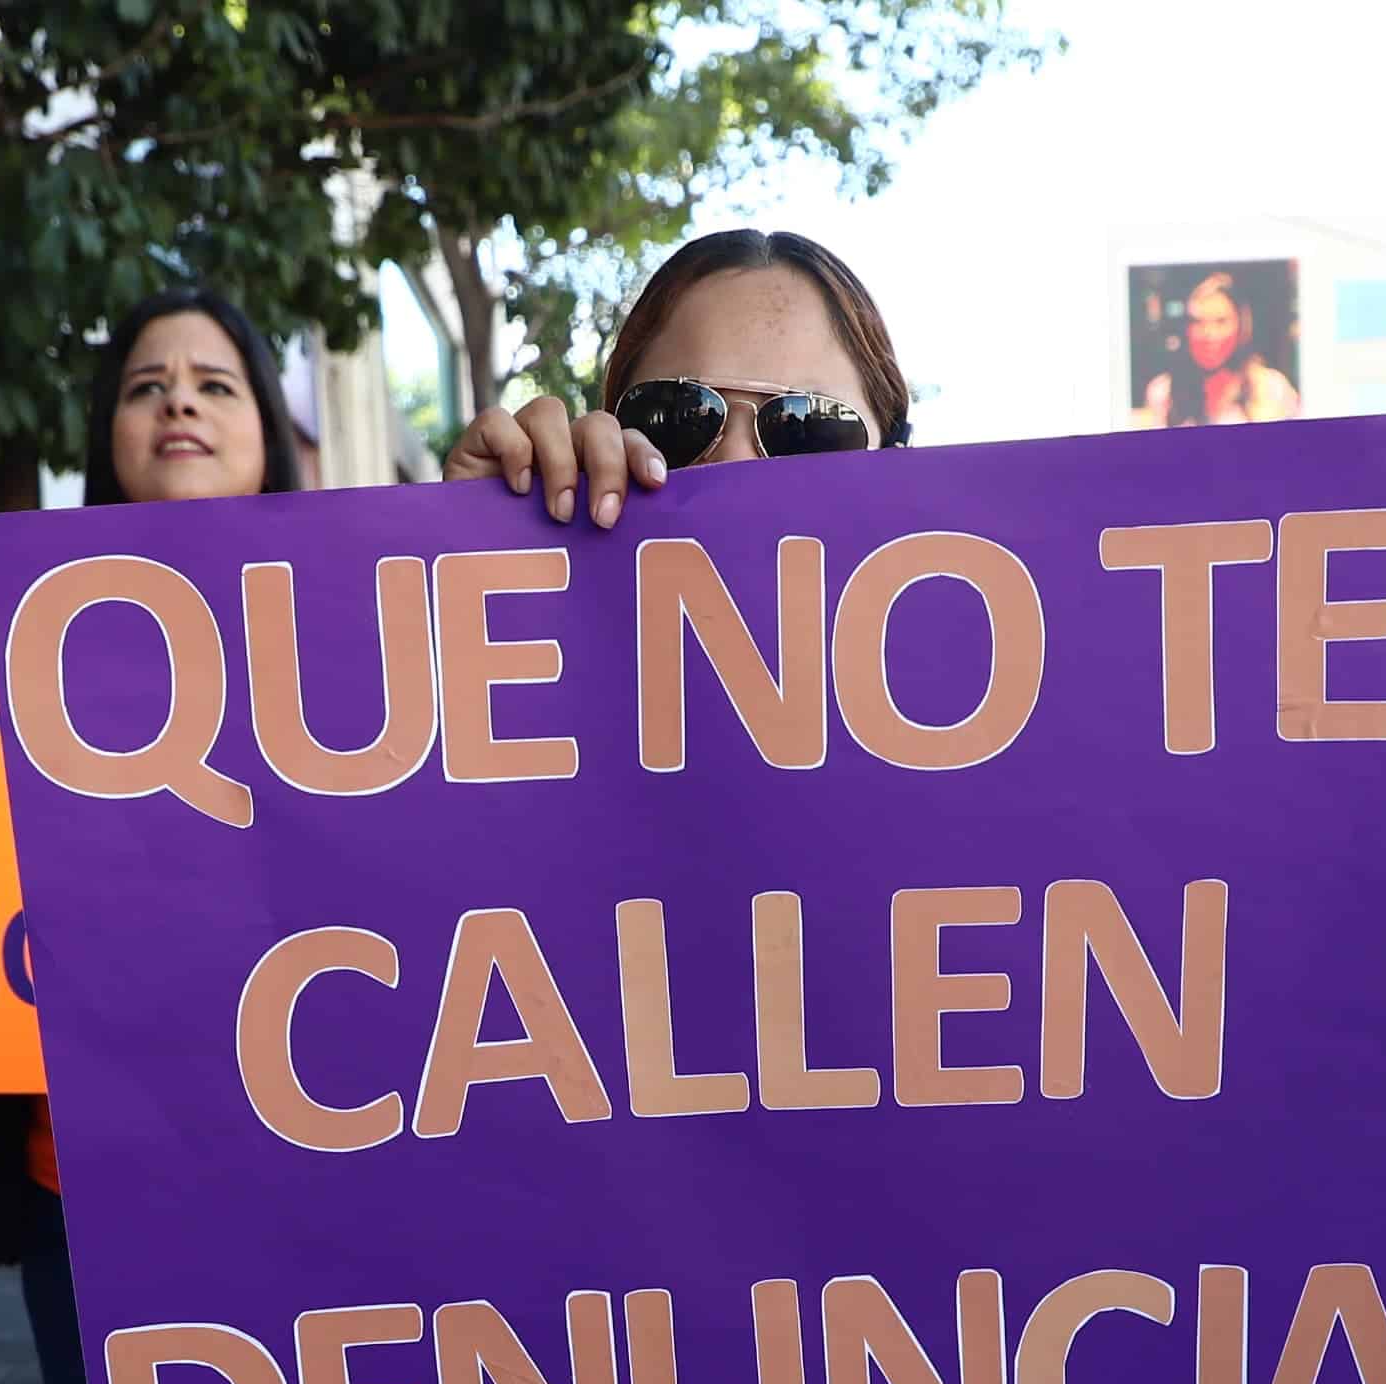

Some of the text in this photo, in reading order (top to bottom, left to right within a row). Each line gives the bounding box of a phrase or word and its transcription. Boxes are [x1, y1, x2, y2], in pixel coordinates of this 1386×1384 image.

[4, 546, 580, 829] QUE
[634, 529, 1047, 773] NO
[235, 878, 1229, 1152] CALLEN
